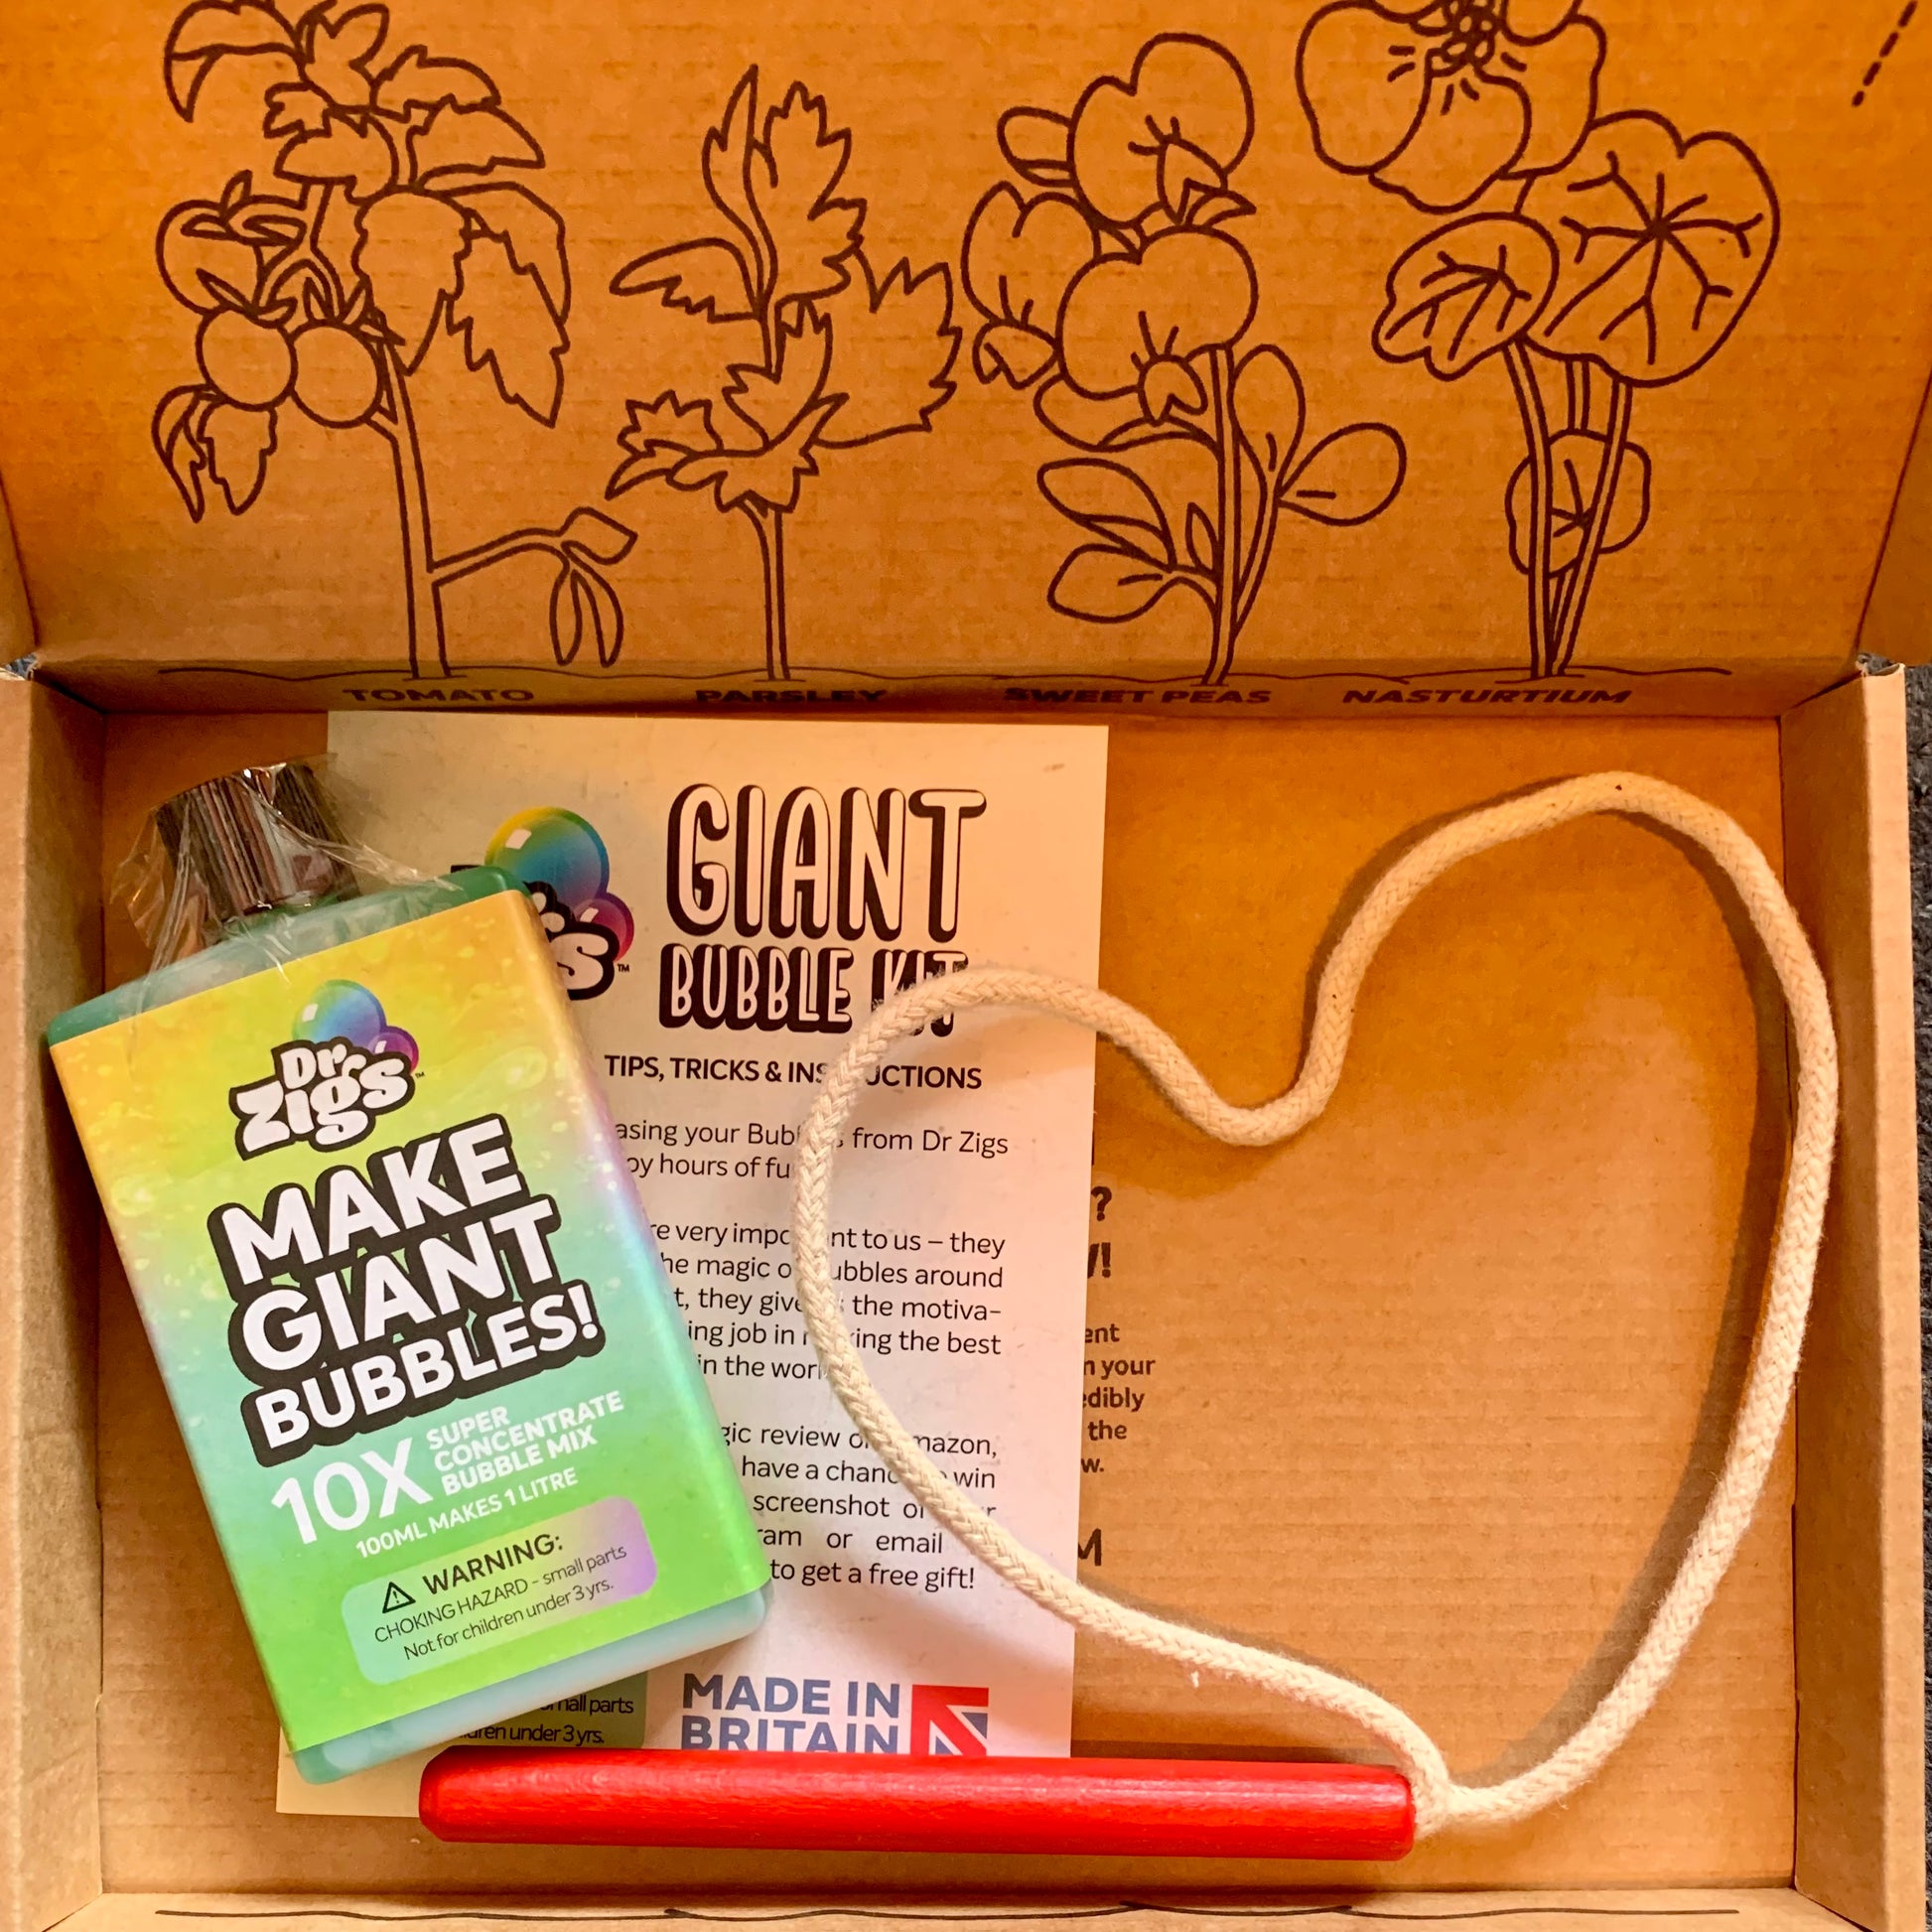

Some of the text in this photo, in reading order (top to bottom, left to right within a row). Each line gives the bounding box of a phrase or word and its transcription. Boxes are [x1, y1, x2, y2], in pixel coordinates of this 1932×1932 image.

[343, 689, 534, 702] TOMATO
[696, 689, 887, 703] PARSLEY
[1005, 688, 1273, 704] SWEET PEAS
[1342, 690, 1632, 704] NASTURTIUM
[667, 783, 987, 942] GIANT
[659, 943, 852, 1033] BUBBLE
[604, 1054, 983, 1089] TIPS, TRICKS & INSUCTIONS
[615, 1120, 677, 1147] asing
[685, 1125, 741, 1147] your
[853, 1127, 912, 1151] from
[923, 1130, 952, 1152] Dr
[959, 1131, 1009, 1159] Zigs
[627, 1153, 790, 1178] oy hours of fu
[216, 1116, 526, 1289] MAKE
[676, 1225, 728, 1247] very
[862, 1229, 888, 1250] to
[895, 1234, 921, 1251] us
[950, 1232, 1006, 1259] they
[238, 1196, 559, 1374] GIANT
[660, 1252, 689, 1274] he
[697, 1257, 770, 1282] magic
[831, 1260, 907, 1284] ubbles
[915, 1267, 1003, 1288] around
[698, 1288, 753, 1315] they
[852, 1294, 893, 1316] the
[901, 1300, 1002, 1320] motiva-
[688, 1320, 723, 1347] ing
[729, 1322, 766, 1347] job
[774, 1324, 795, 1345] in
[898, 1329, 939, 1351] the
[947, 1331, 1002, 1355] best
[1084, 1323, 1121, 1343] ent
[250, 1283, 601, 1453] BUBBLES!
[725, 1355, 764, 1377] the
[1101, 1359, 1156, 1380] your
[426, 1406, 510, 1450] SUPER
[434, 1390, 624, 1472] CONCENTRATE
[722, 1423, 752, 1447] gic
[760, 1426, 841, 1448] review
[912, 1436, 997, 1458] mazon,
[1088, 1420, 1127, 1441] the
[441, 1424, 599, 1497] BUBBLE MIX
[742, 1455, 799, 1478] have
[805, 1463, 818, 1479] a
[826, 1460, 899, 1483] chanc
[954, 1467, 996, 1489] win
[270, 1437, 434, 1545] 10X
[753, 1494, 890, 1517] screenshot
[355, 1466, 579, 1559] 100ML MAKES 1 LITRE
[827, 1533, 853, 1549] or
[877, 1532, 942, 1554] email
[422, 1533, 563, 1595] WARNING:
[770, 1560, 975, 1592] to get a free gift!
[374, 1603, 456, 1644] CHOKING
[458, 1578, 528, 1615] HAZARD
[542, 1558, 584, 1586] small
[586, 1546, 627, 1574] parts
[403, 1579, 615, 1660] Not for children under 3 yrs.
[589, 1697, 633, 1715] parts
[683, 1673, 900, 1719] MADE IN
[509, 1725, 561, 1742] under
[563, 1725, 575, 1742] 3
[576, 1729, 605, 1746] yrs.
[681, 1715, 898, 1753] BRITAIN
